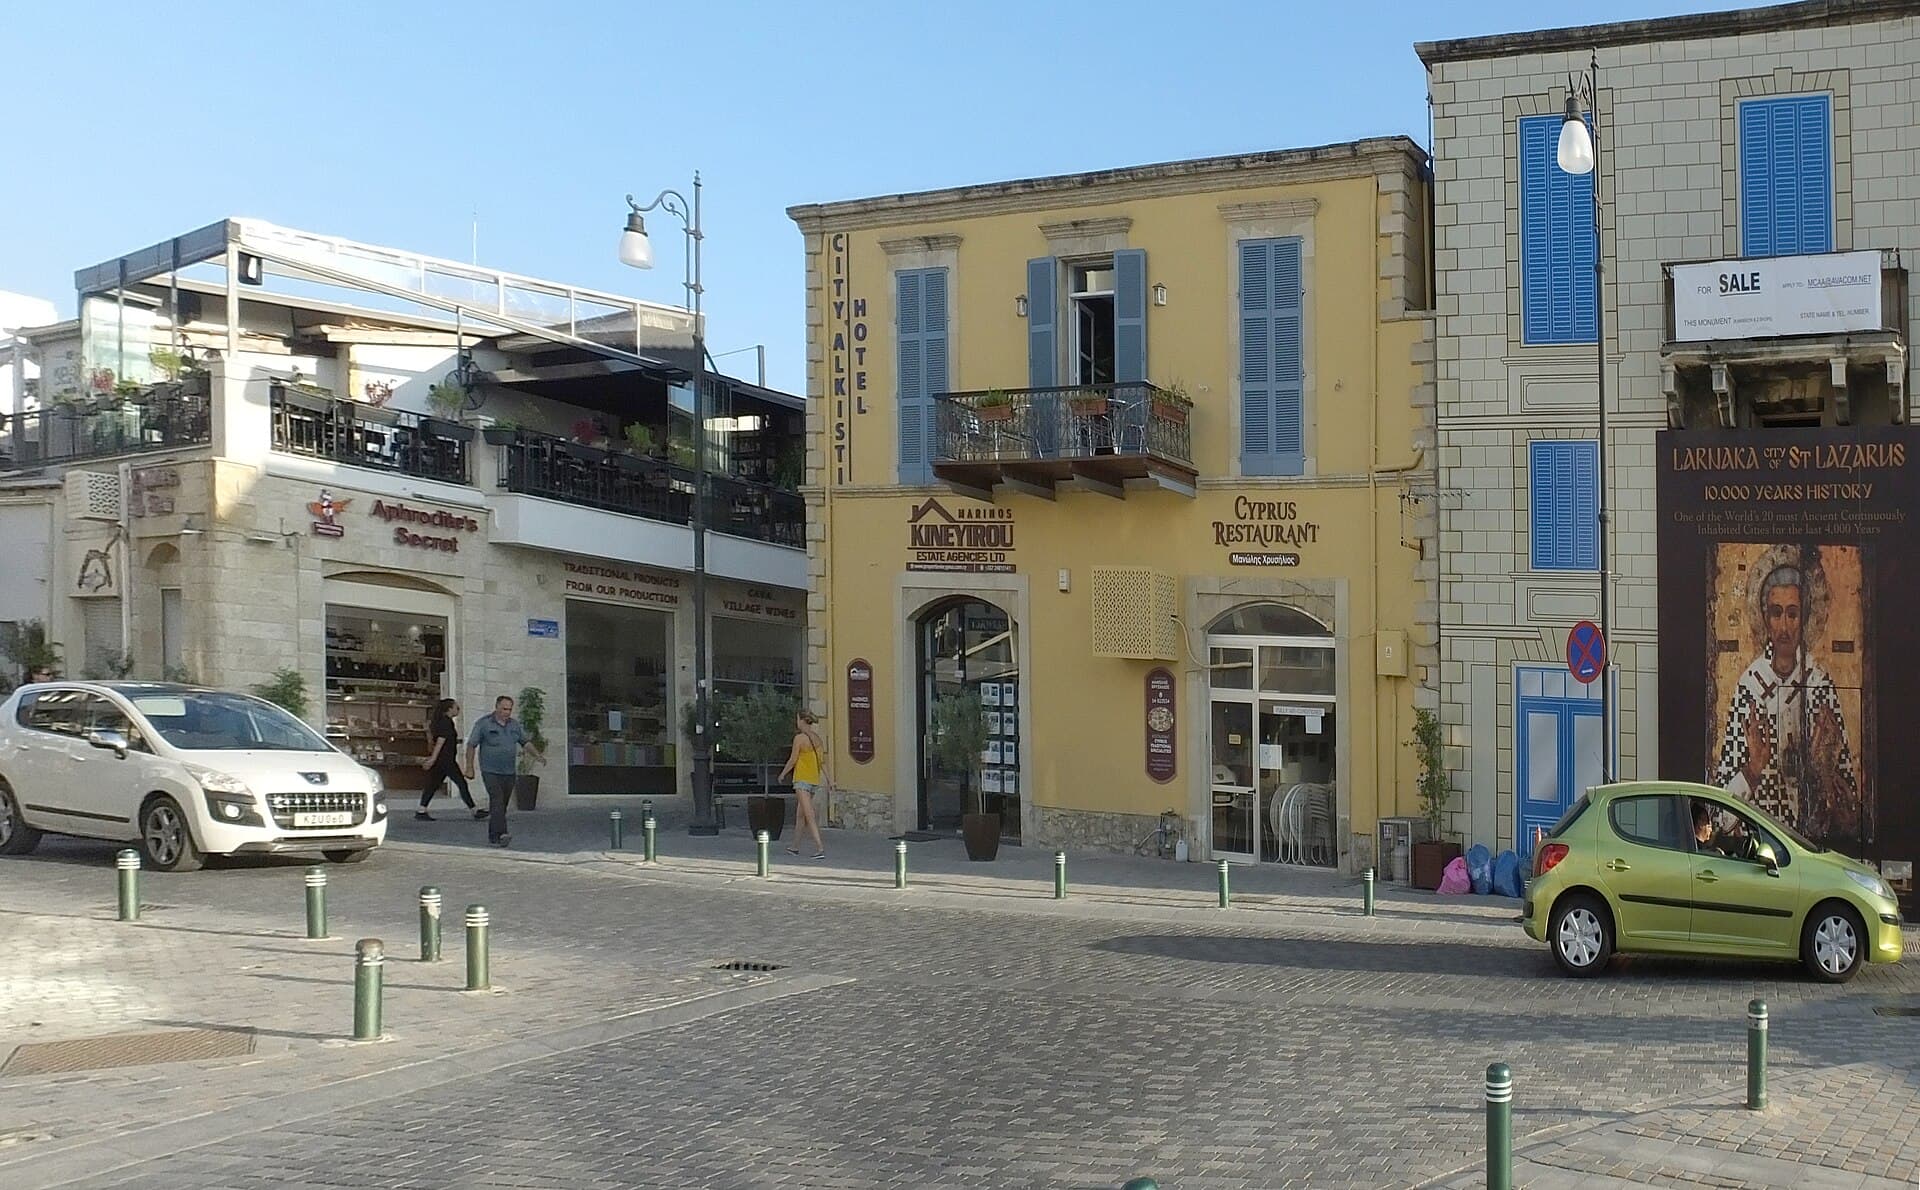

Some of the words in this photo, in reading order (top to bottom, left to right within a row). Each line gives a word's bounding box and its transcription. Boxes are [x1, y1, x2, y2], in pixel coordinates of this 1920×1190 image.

[832, 233, 844, 320] CITY
[1697, 286, 1712, 295] FOR
[1719, 272, 1761, 294] SALE
[1683, 319, 1697, 327] THIS
[1697, 317, 1732, 326] MONUMENT
[853, 298, 868, 415] HOTEL
[832, 332, 846, 486] ALKISTI
[1673, 447, 1760, 471] LARNAKA
[1763, 447, 1787, 458] CITY
[1815, 443, 1906, 475] LAZARUS
[1768, 459, 1780, 470] OF
[1754, 484, 1804, 501] YEARS
[1806, 483, 1873, 500] HISTORY
[371, 499, 479, 533] Aphrodite's
[958, 508, 1013, 519] MARINOS
[1673, 511, 1694, 522] One
[1695, 511, 1705, 521] of
[1706, 511, 1722, 521] the
[1724, 510, 1760, 522] World's
[1761, 510, 1774, 521] 20
[1776, 511, 1798, 521] most
[1803, 510, 1838, 521] Ancient
[1840, 508, 1905, 523] Continuously
[395, 527, 460, 553] Secret
[911, 524, 1014, 548] KINEYIROU
[1697, 523, 1741, 535] Inhabited
[1743, 523, 1770, 535] Cities
[1772, 524, 1785, 535] for
[1788, 523, 1803, 535] the
[1805, 523, 1821, 535] last
[1854, 523, 1881, 535] Years
[916, 551, 946, 562] ESTATE
[946, 551, 989, 563] AGENCIES
[989, 552, 1006, 563] LTD
[563, 561, 632, 582] TRADITIONAL
[633, 571, 680, 589] PRODUCTS
[565, 580, 593, 593] FROM
[596, 584, 617, 596] OUR
[618, 587, 679, 604] PRODUCTION
[722, 600, 762, 615] VILLAGE
[765, 606, 796, 619] WINES
